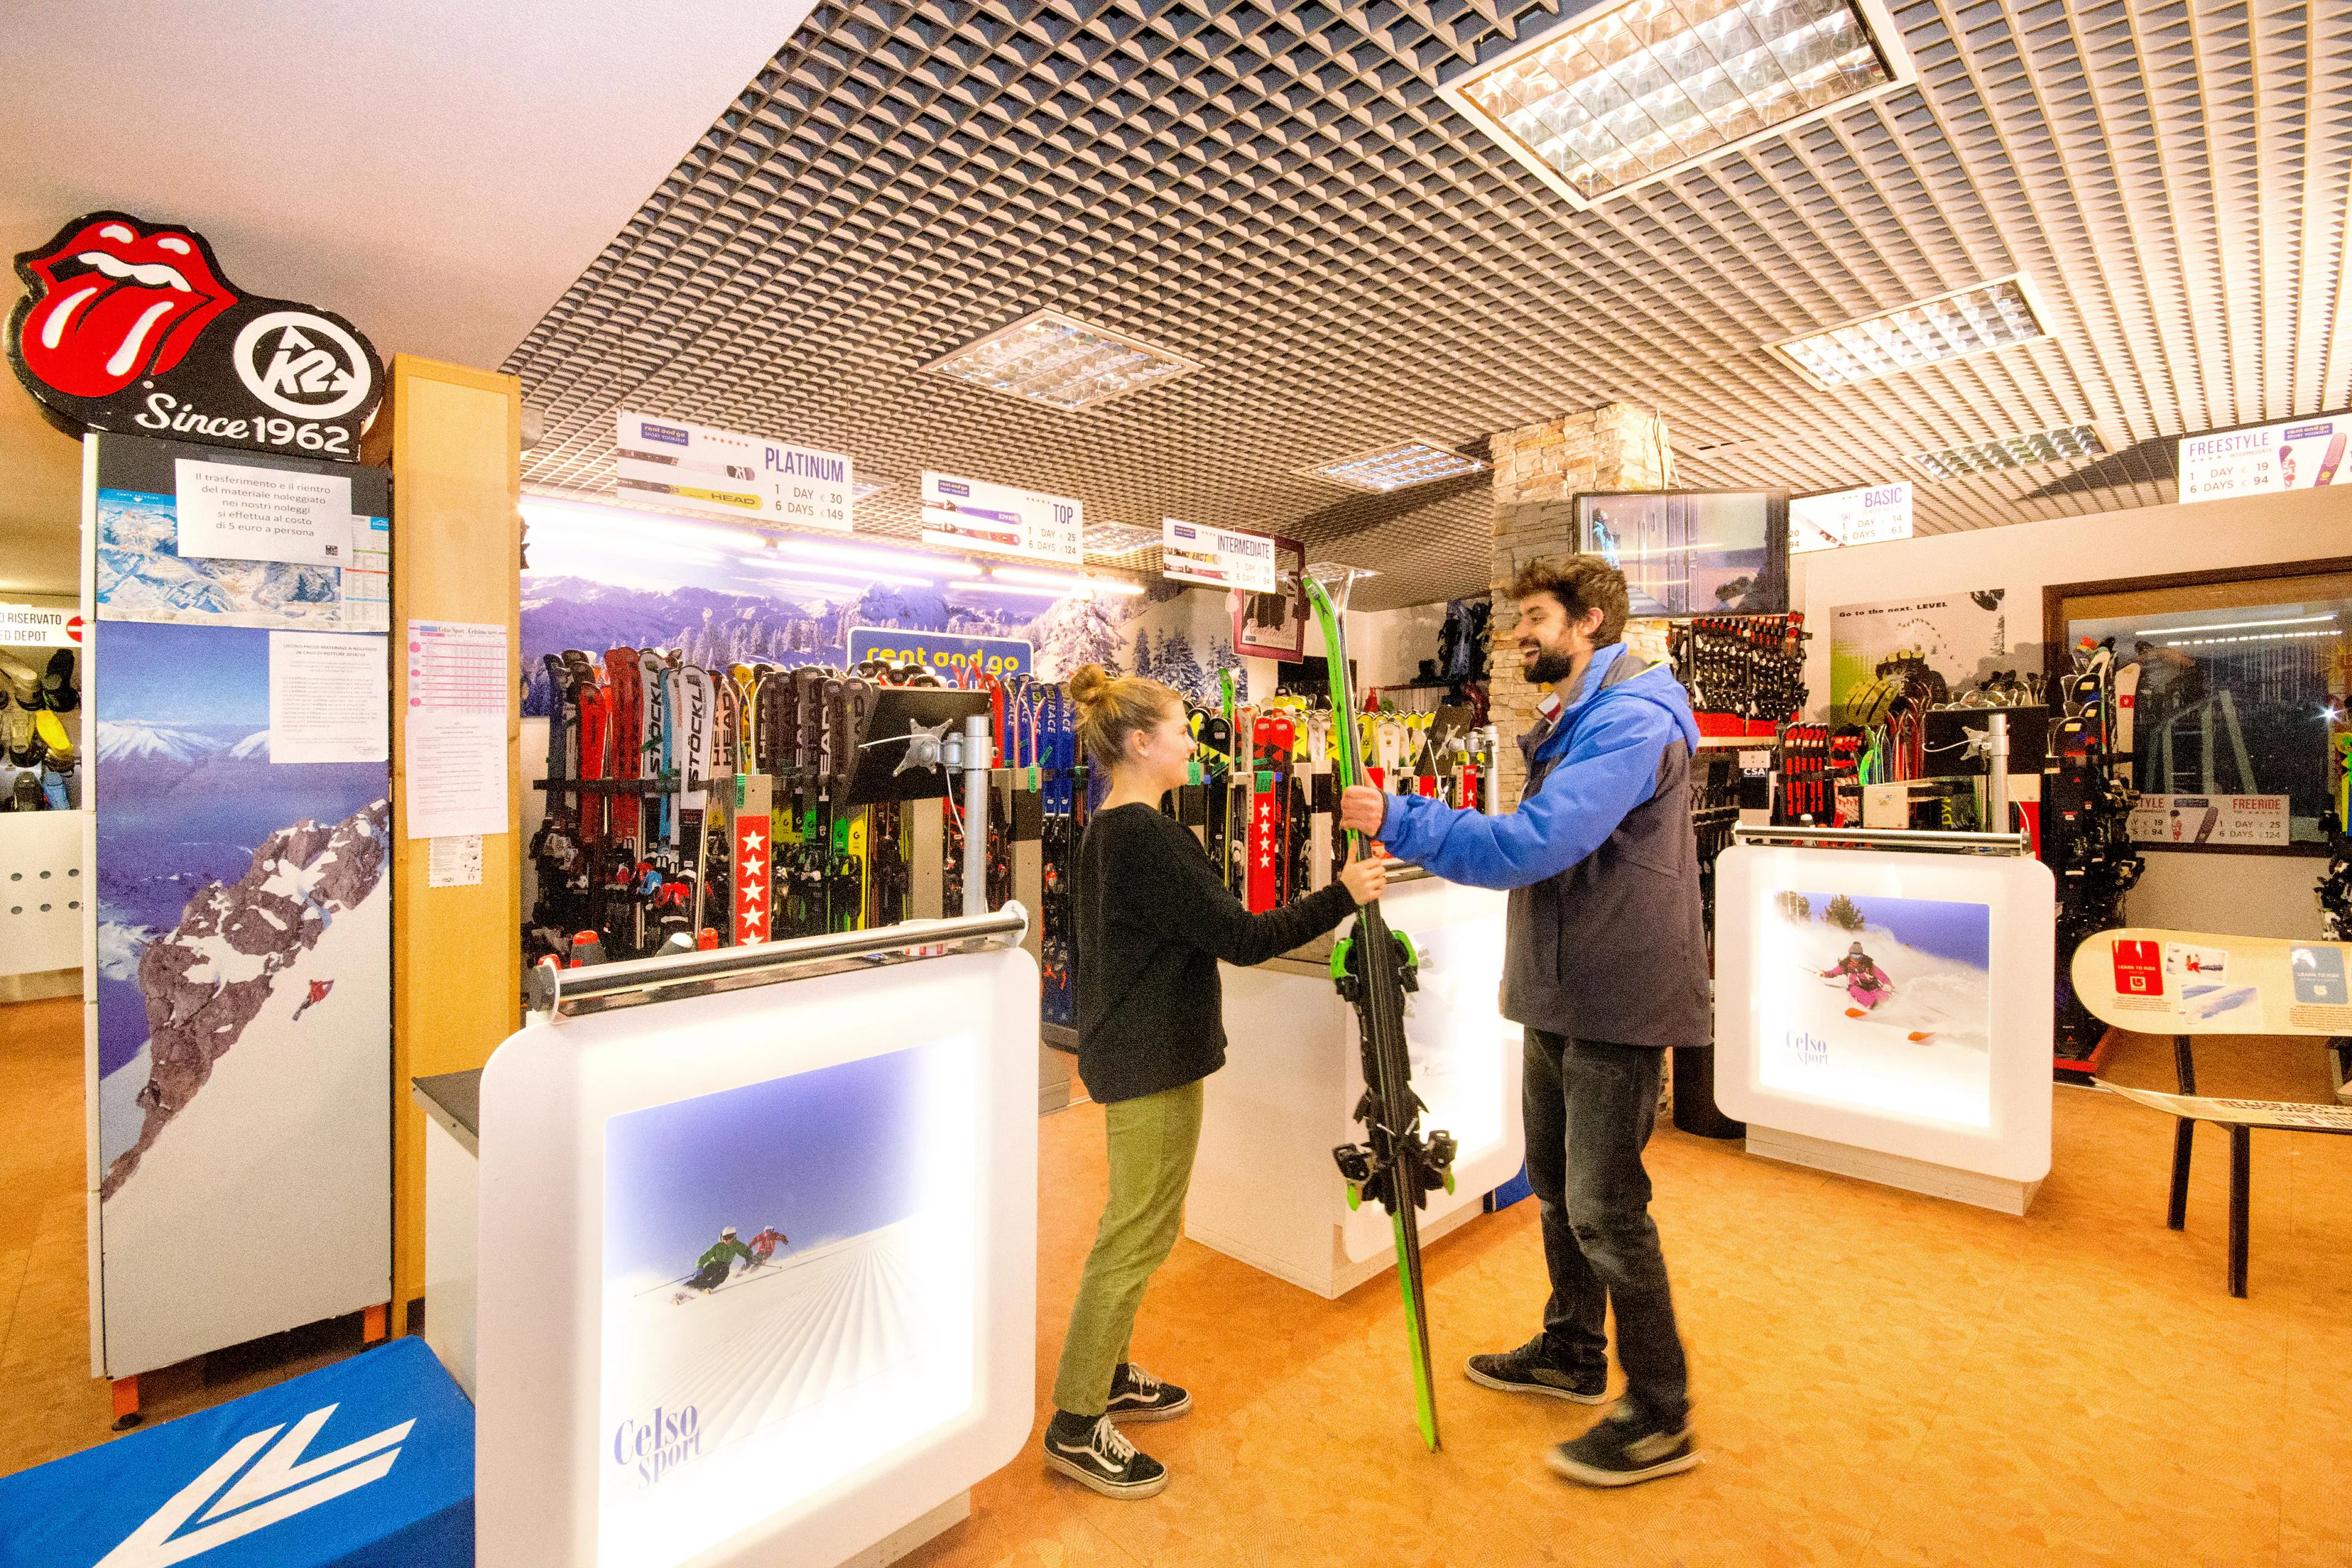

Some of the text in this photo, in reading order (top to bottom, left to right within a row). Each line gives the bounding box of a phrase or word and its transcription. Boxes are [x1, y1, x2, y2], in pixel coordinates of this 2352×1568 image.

[263, 326, 356, 394] K2
[135, 391, 350, 454] Since 1962
[2190, 432, 2269, 456] FREESTYLE
[2229, 448, 2274, 458] INTERMEDIATE
[766, 447, 844, 483] PLATINUM
[2190, 472, 2194, 481] 1
[2211, 467, 2234, 478] DAY
[2256, 462, 2269, 472] 19
[205, 474, 276, 489] trasferimento
[297, 484, 331, 494] rientro
[2190, 485, 2196, 494] 6
[2204, 480, 2234, 492] DAYS
[2253, 476, 2269, 484] 94
[221, 488, 270, 499] materiale
[273, 492, 326, 505] noleggiato
[710, 493, 756, 505] HEAD
[775, 484, 779, 494] 1
[793, 488, 814, 500] DAY
[830, 494, 842, 504] 30
[1865, 488, 1902, 508] BASIC
[241, 501, 271, 510] nostri
[274, 504, 311, 515] noleggi
[775, 500, 782, 511] 6
[788, 502, 814, 516] DAYS
[1053, 503, 1074, 525] TOP
[229, 511, 270, 521] effettua
[285, 516, 312, 525] costo
[1858, 519, 1875, 528] DAY
[274, 527, 314, 537] persona
[1028, 526, 1031, 535] 1
[1041, 529, 1055, 539] DAY
[1068, 533, 1076, 542] 25
[1853, 530, 1875, 540] DAYS
[1038, 542, 1056, 552] DAYS
[1218, 535, 1270, 559] INTERMEDIATE
[1917, 601, 1948, 610] LEVEL
[8, 612, 61, 625] RISERVATO
[15, 630, 47, 642] DEPOT
[867, 647, 1019, 675] rent and go
[722, 692, 733, 766] HEAD
[2233, 798, 2281, 809] FREERIDE
[1786, 1030, 1827, 1054] Celso
[1797, 1050, 1829, 1066] sport
[614, 1405, 698, 1465] Celso
[638, 1427, 703, 1490] sport
